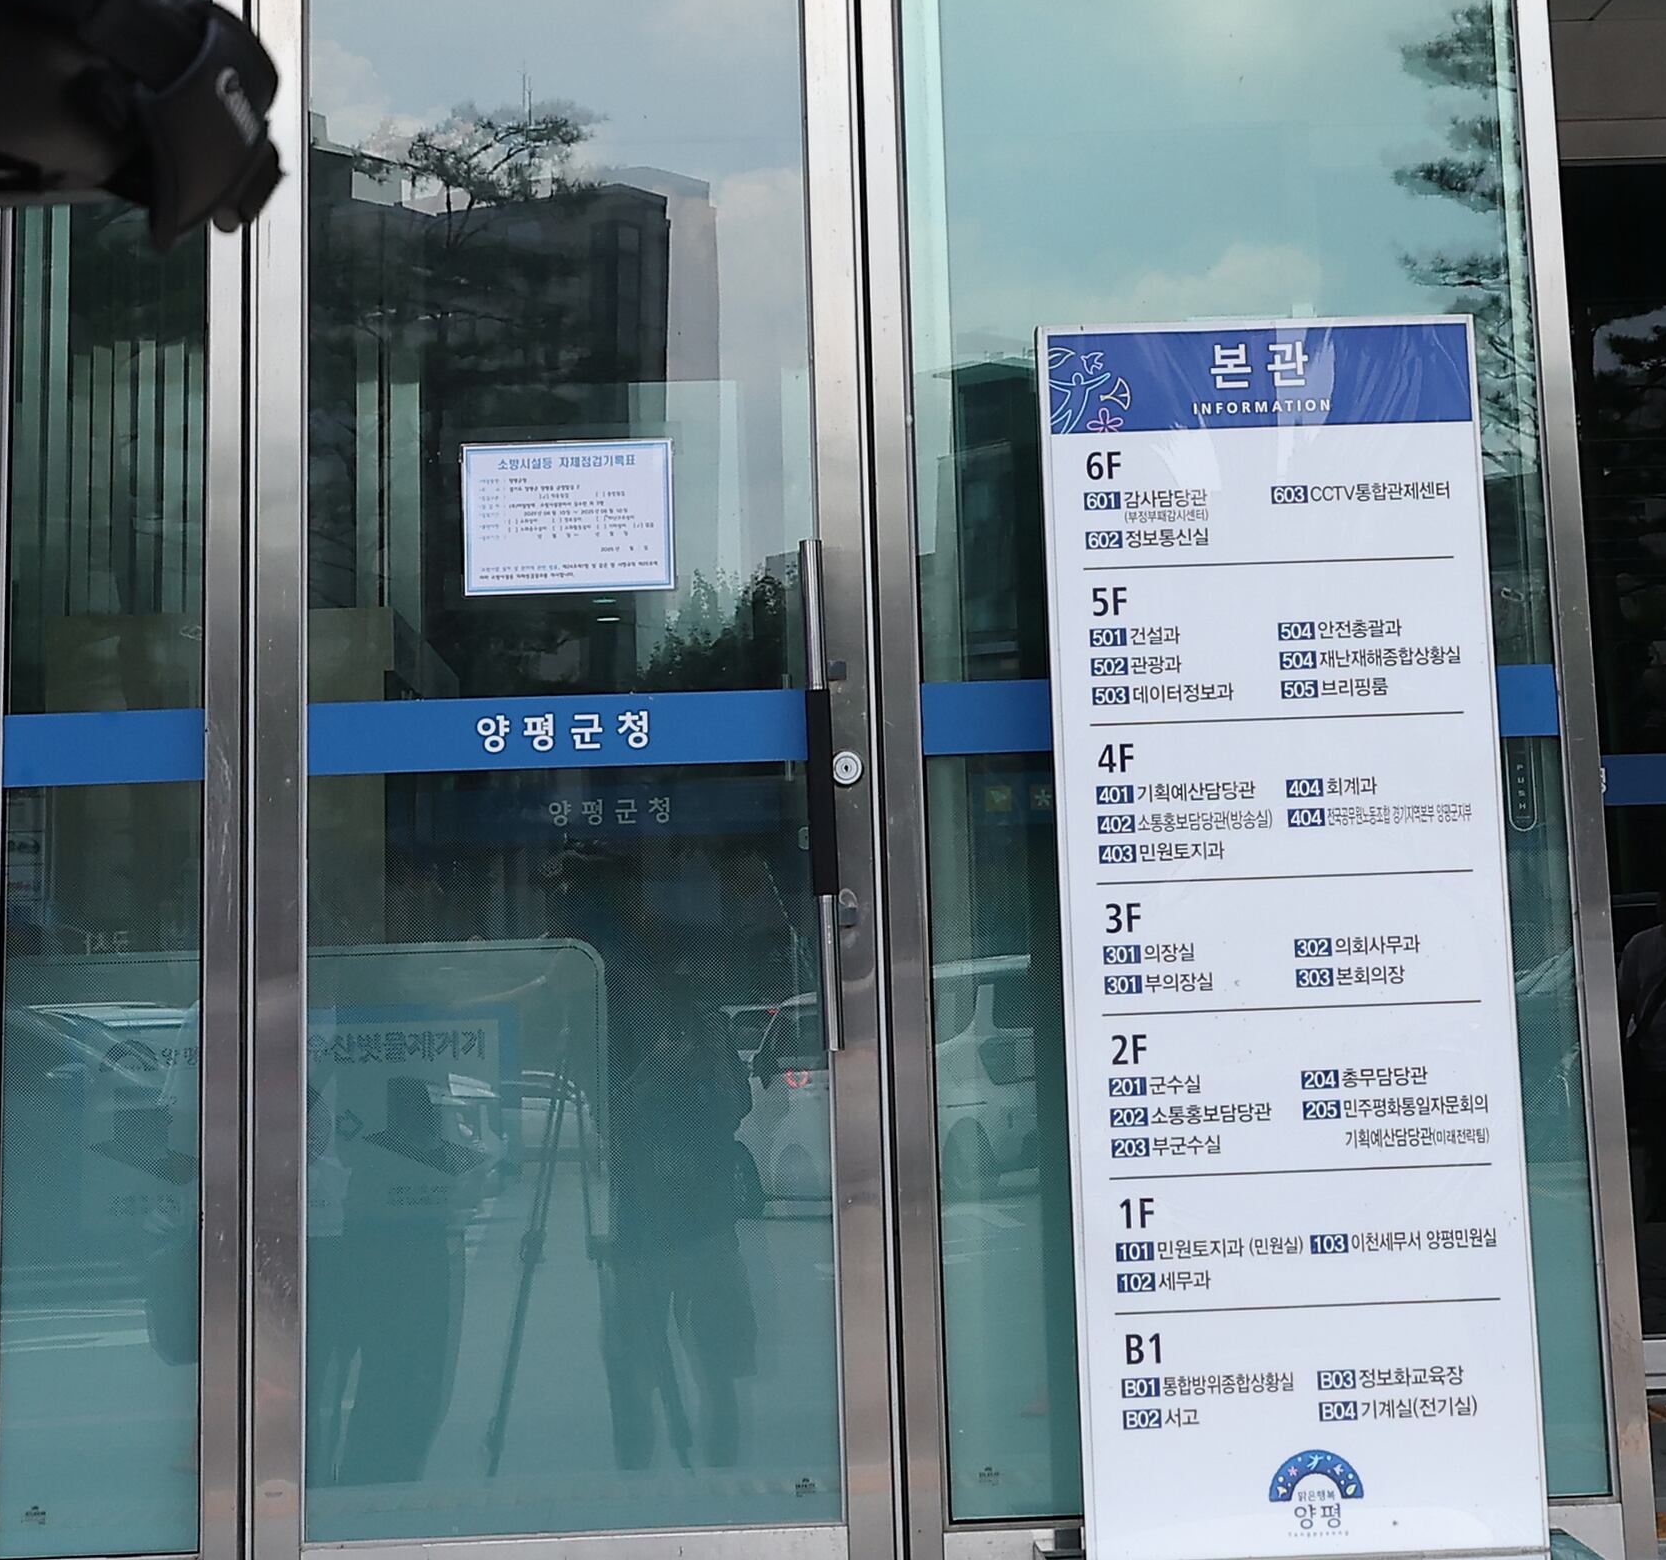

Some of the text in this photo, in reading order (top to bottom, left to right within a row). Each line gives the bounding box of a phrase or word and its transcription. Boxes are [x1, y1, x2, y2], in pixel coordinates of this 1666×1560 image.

[1209, 342, 1310, 389] 본관
[1193, 398, 1331, 416] INFORMATION
[1085, 451, 1121, 480] 6F
[1085, 489, 1207, 509] 601 감사담당관
[1273, 481, 1451, 503] 603 CCTV통합관제센터
[1087, 528, 1209, 548] 602 정보통신실
[1092, 587, 1127, 616] 5F
[1092, 626, 1180, 646] 501 건설과
[1279, 619, 1401, 640] 504 안전총괄과
[1093, 655, 1181, 674] 502 관광과
[1281, 645, 1461, 668] 504 재난재해종합상황실
[1094, 682, 1234, 704] 503 데이터정보과
[1283, 677, 1388, 697] 505 브리핑룸
[477, 710, 651, 753] 양평군청
[1098, 743, 1134, 773] 4F
[1098, 782, 1255, 803] 401 기획예산담당관
[1288, 777, 1377, 797] 404 회계과
[549, 797, 672, 826] 양평군청
[1099, 809, 1273, 832] 402 소통홍보담당관(방송실)
[1290, 809, 1323, 826] 404
[1101, 841, 1225, 863] 403 민원토지과
[1105, 902, 1141, 933] 3F
[1106, 942, 1194, 964] 301 의장실
[1296, 935, 1420, 956] 302 의회사무과
[1107, 972, 1214, 993] 301 부의장실
[1298, 965, 1405, 986] 303 본회의장
[1111, 1034, 1147, 1065] 2F
[1111, 1074, 1201, 1096] 201 군수실
[1303, 1066, 1427, 1088] 204 총무담당관
[1112, 1103, 1272, 1125] 202 소통홍보담당관
[1305, 1095, 1489, 1118] 205 민주평화통일자문회의
[1114, 1135, 1221, 1156] 203 부군수실
[1119, 1197, 1154, 1229] 1F
[1119, 1236, 1303, 1260] 101 민원토지과 (민원실)
[1314, 1228, 1497, 1252] 103 이천세무서 양평민원실
[1120, 1270, 1211, 1291] 102 세무과
[1125, 1333, 1162, 1365] B1
[1125, 1372, 1294, 1396] B01 통합방위종합상황실
[1321, 1365, 1464, 1388] B03 정보화교육장
[1126, 1407, 1200, 1428] B02 서고
[1322, 1396, 1477, 1420] B04 기계실(전기실)
[1294, 1503, 1341, 1529] 양평
